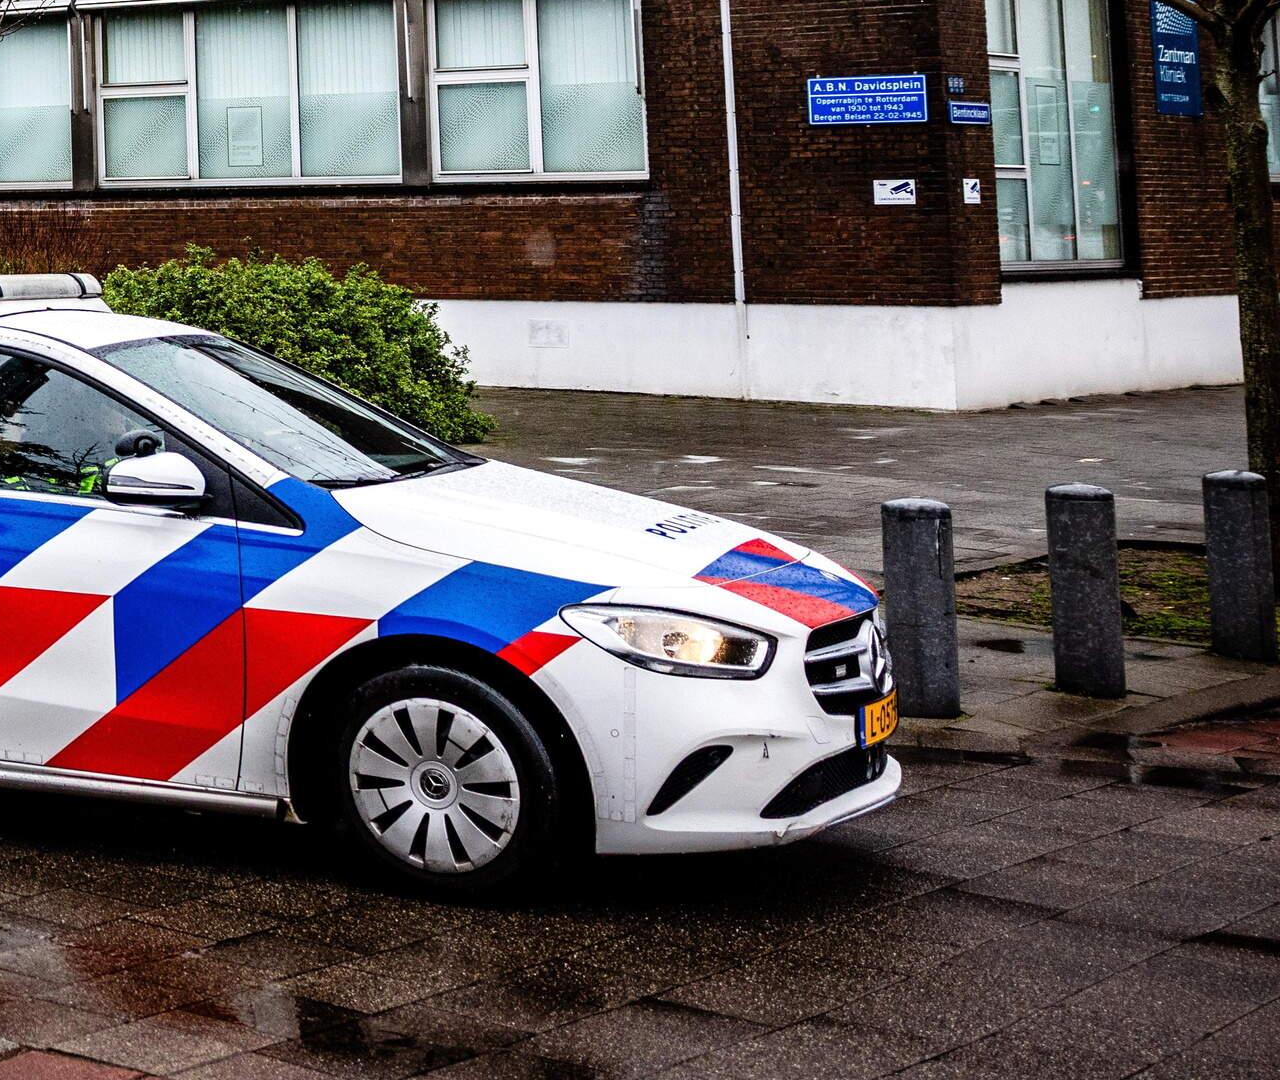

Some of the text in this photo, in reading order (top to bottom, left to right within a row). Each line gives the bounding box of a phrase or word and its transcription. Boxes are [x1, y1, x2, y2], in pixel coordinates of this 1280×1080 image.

[1158, 44, 1196, 64] Zantman
[814, 80, 921, 92] A.B.N. Davidsplein
[816, 97, 863, 105] Opperrabijn
[875, 95, 919, 103] Rotterdam
[883, 103, 904, 111] 1943
[814, 114, 842, 122] Bergen
[873, 111, 922, 119] 22-02-1945
